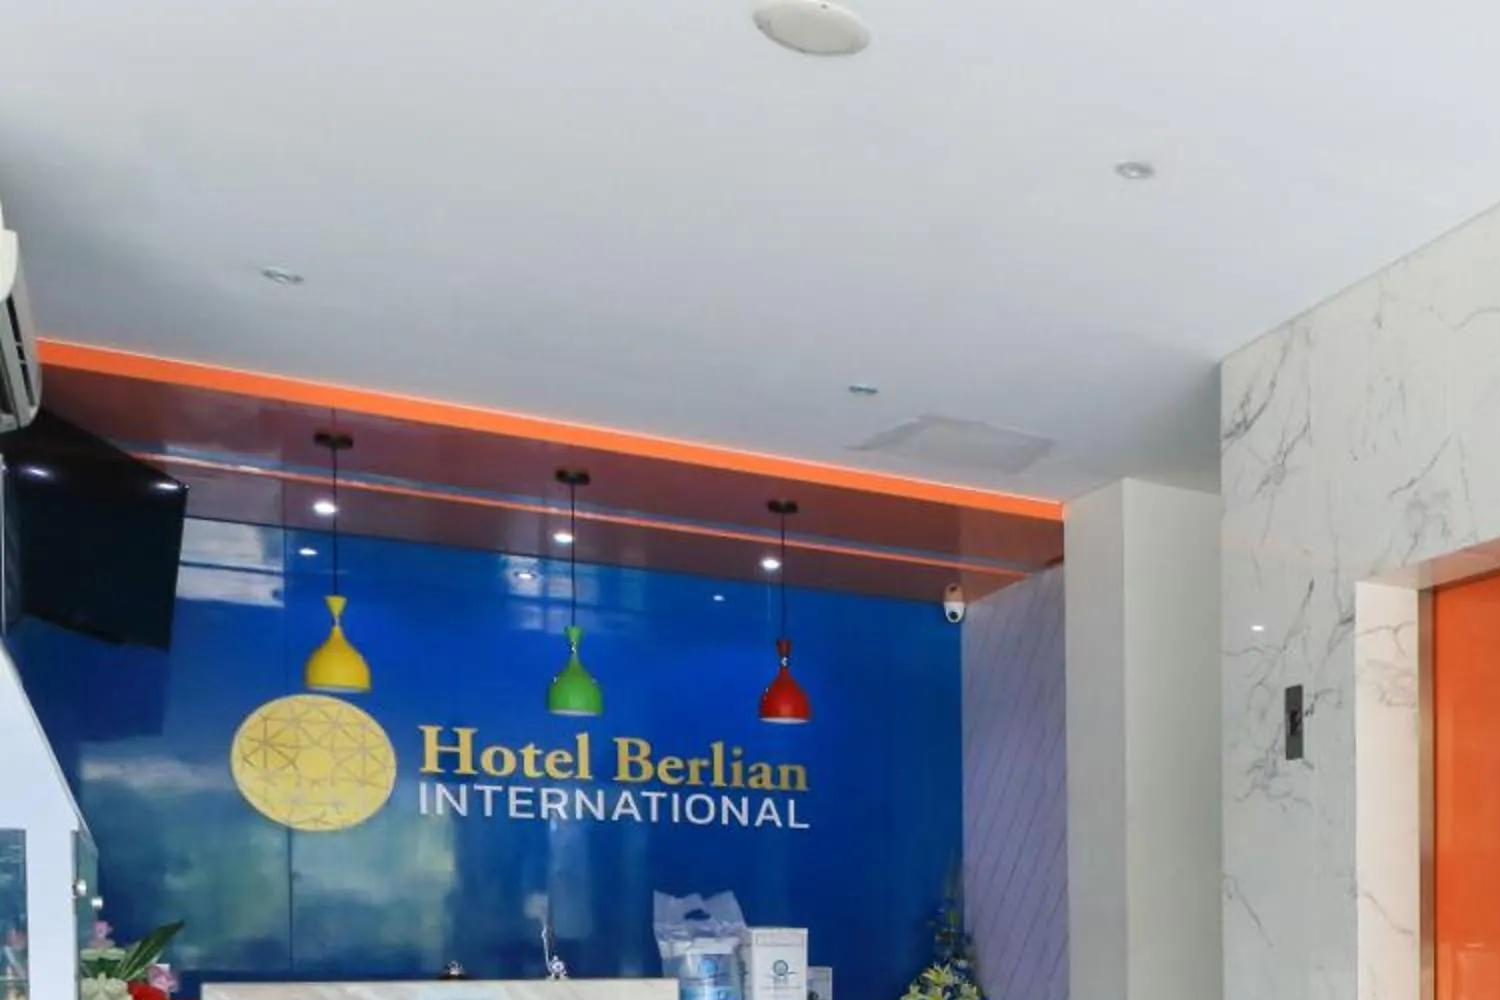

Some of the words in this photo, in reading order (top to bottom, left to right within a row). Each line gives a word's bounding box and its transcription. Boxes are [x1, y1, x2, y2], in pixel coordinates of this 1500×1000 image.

[417, 724, 592, 781] Hotel
[613, 736, 810, 792] Berlian
[418, 781, 811, 829] INTERNATIONAL
